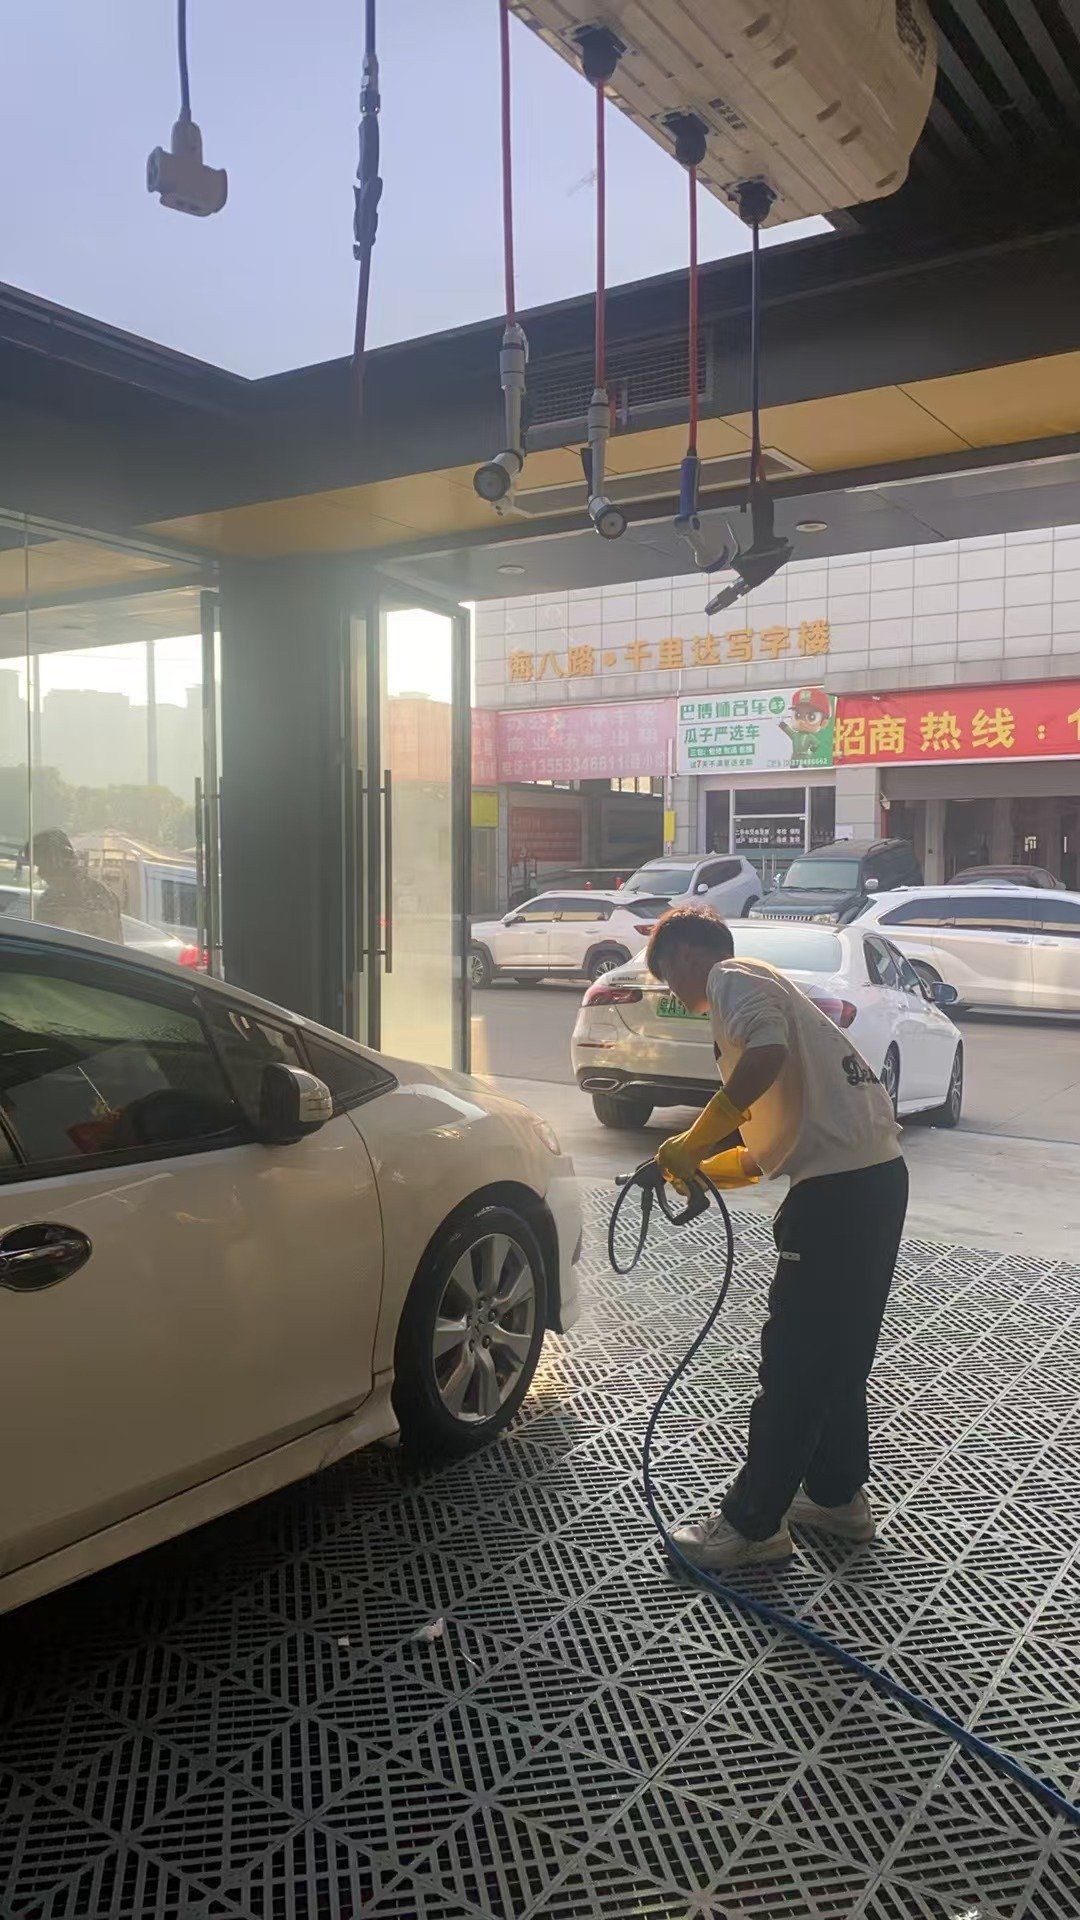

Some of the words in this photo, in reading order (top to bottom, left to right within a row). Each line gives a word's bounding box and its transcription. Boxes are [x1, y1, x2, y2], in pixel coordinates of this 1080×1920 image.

[684, 724, 760, 744] 瓜子严选车
